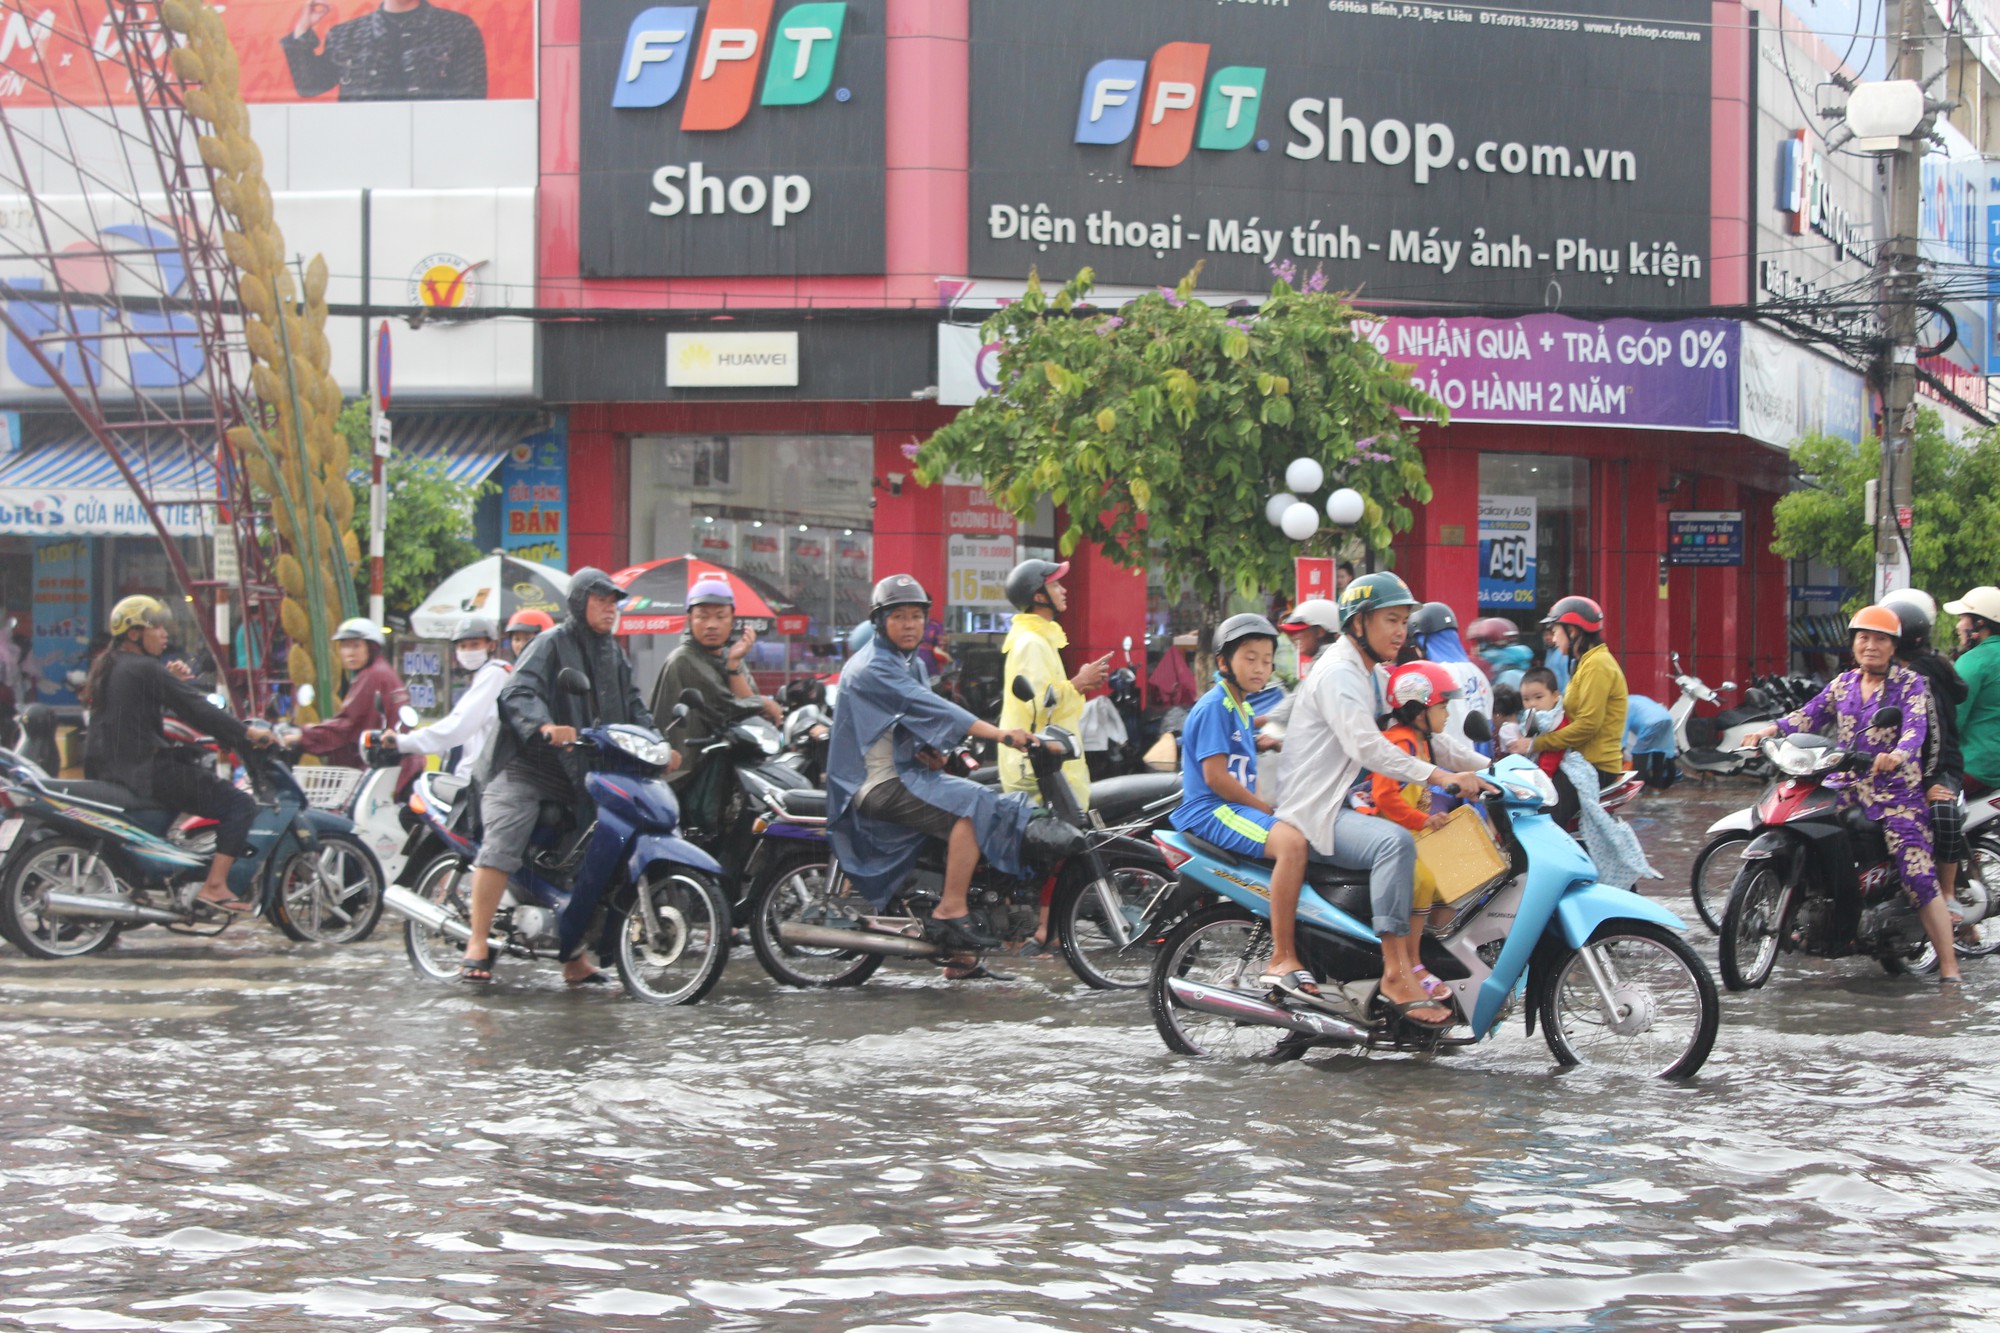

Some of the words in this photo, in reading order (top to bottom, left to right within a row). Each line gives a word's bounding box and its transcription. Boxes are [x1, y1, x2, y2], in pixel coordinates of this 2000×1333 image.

[1583, 21, 1702, 42] www.fptshop.com.vn
[625, 27, 834, 83] FPT
[1089, 78, 1259, 129] FPT
[648, 161, 812, 227] Shop
[987, 202, 1077, 253] Điện
[1085, 209, 1183, 260] thoại
[1206, 216, 1284, 264] Máy
[1290, 219, 1362, 260] tính
[1388, 226, 1463, 274] Máy
[1469, 227, 1533, 269] ảnh
[1555, 238, 1620, 286] Phụ
[1629, 240, 1702, 288] kiện
[717, 352, 788, 368] HUAWEI
[1397, 317, 1472, 367] NHẬN
[1476, 321, 1532, 361] QUÀ
[1562, 324, 1612, 364] TRẢ
[1616, 328, 1673, 367] GÓP
[1679, 328, 1728, 370] 0%
[1470, 371, 1544, 412] HÀNH
[1548, 382, 1565, 413] 2
[1568, 375, 1626, 415] NĂM
[113, 498, 157, 525] HÀN
[508, 503, 562, 535] BÁN
[1513, 506, 1532, 517] A50
[1488, 535, 1529, 582] A50
[951, 569, 978, 601] 15
[1513, 588, 1534, 603] 0%
